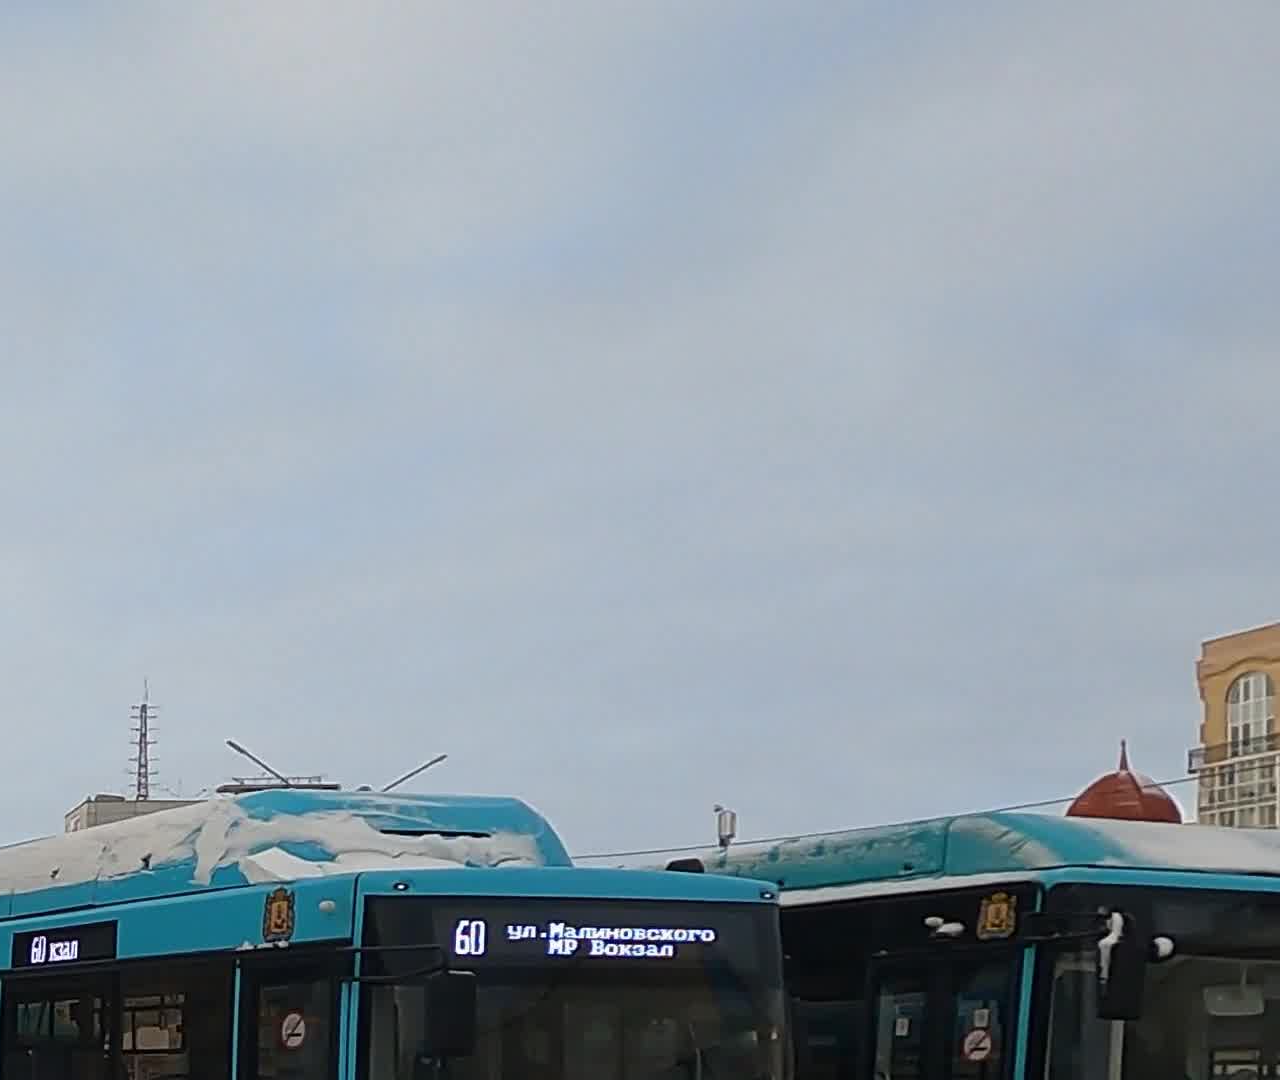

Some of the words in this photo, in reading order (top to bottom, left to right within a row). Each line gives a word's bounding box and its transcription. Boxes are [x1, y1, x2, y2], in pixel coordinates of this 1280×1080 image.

[30, 936, 47, 964] 60
[455, 920, 486, 955] 60
[548, 939, 578, 955] МР
[589, 939, 674, 957] Вокзал
